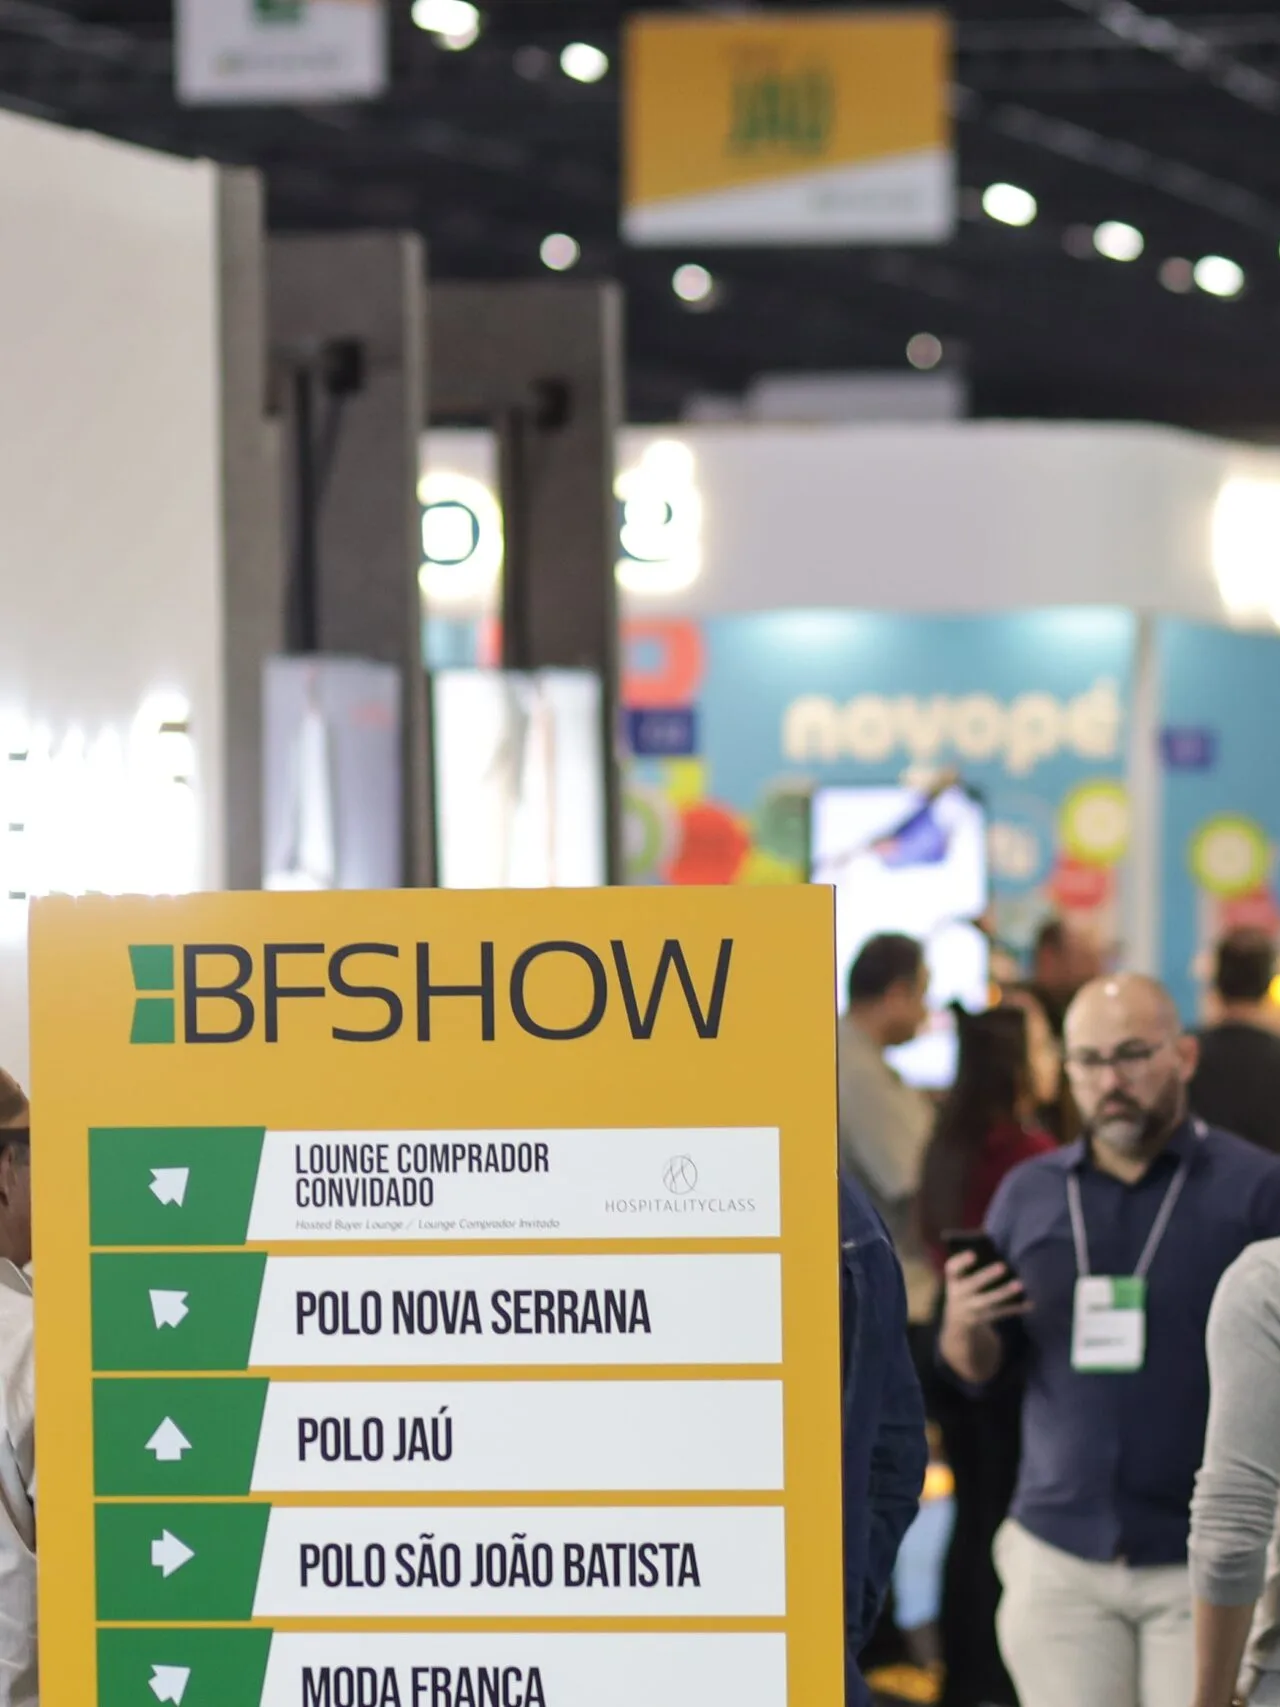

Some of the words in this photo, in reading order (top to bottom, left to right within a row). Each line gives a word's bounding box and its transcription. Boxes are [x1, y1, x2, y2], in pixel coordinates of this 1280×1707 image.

[182, 937, 735, 1043] BFSHOW
[295, 1143, 390, 1174] LOUNGE
[397, 1142, 550, 1174] COMPRADOR
[295, 1177, 434, 1208] CONVIDADO
[604, 1198, 756, 1213] HOSPITALITYCLASS
[295, 1219, 332, 1230] Hosted
[334, 1219, 362, 1232] Buyer
[366, 1219, 403, 1232] Lounge
[418, 1219, 456, 1231] Lounge
[459, 1218, 516, 1231] Comprador
[518, 1218, 561, 1229] Invitado
[296, 1290, 382, 1336] POLO
[392, 1289, 483, 1335] NOVA
[490, 1289, 652, 1335] SERRANA
[298, 1416, 384, 1462] POLO
[392, 1406, 453, 1462] JAÚ
[299, 1542, 386, 1588] POLO
[395, 1532, 461, 1588] SÃO
[470, 1532, 554, 1588] JOÃO
[563, 1542, 701, 1588] BATISTA
[301, 1666, 402, 1707] MODA
[411, 1666, 547, 1707] FRANCA
